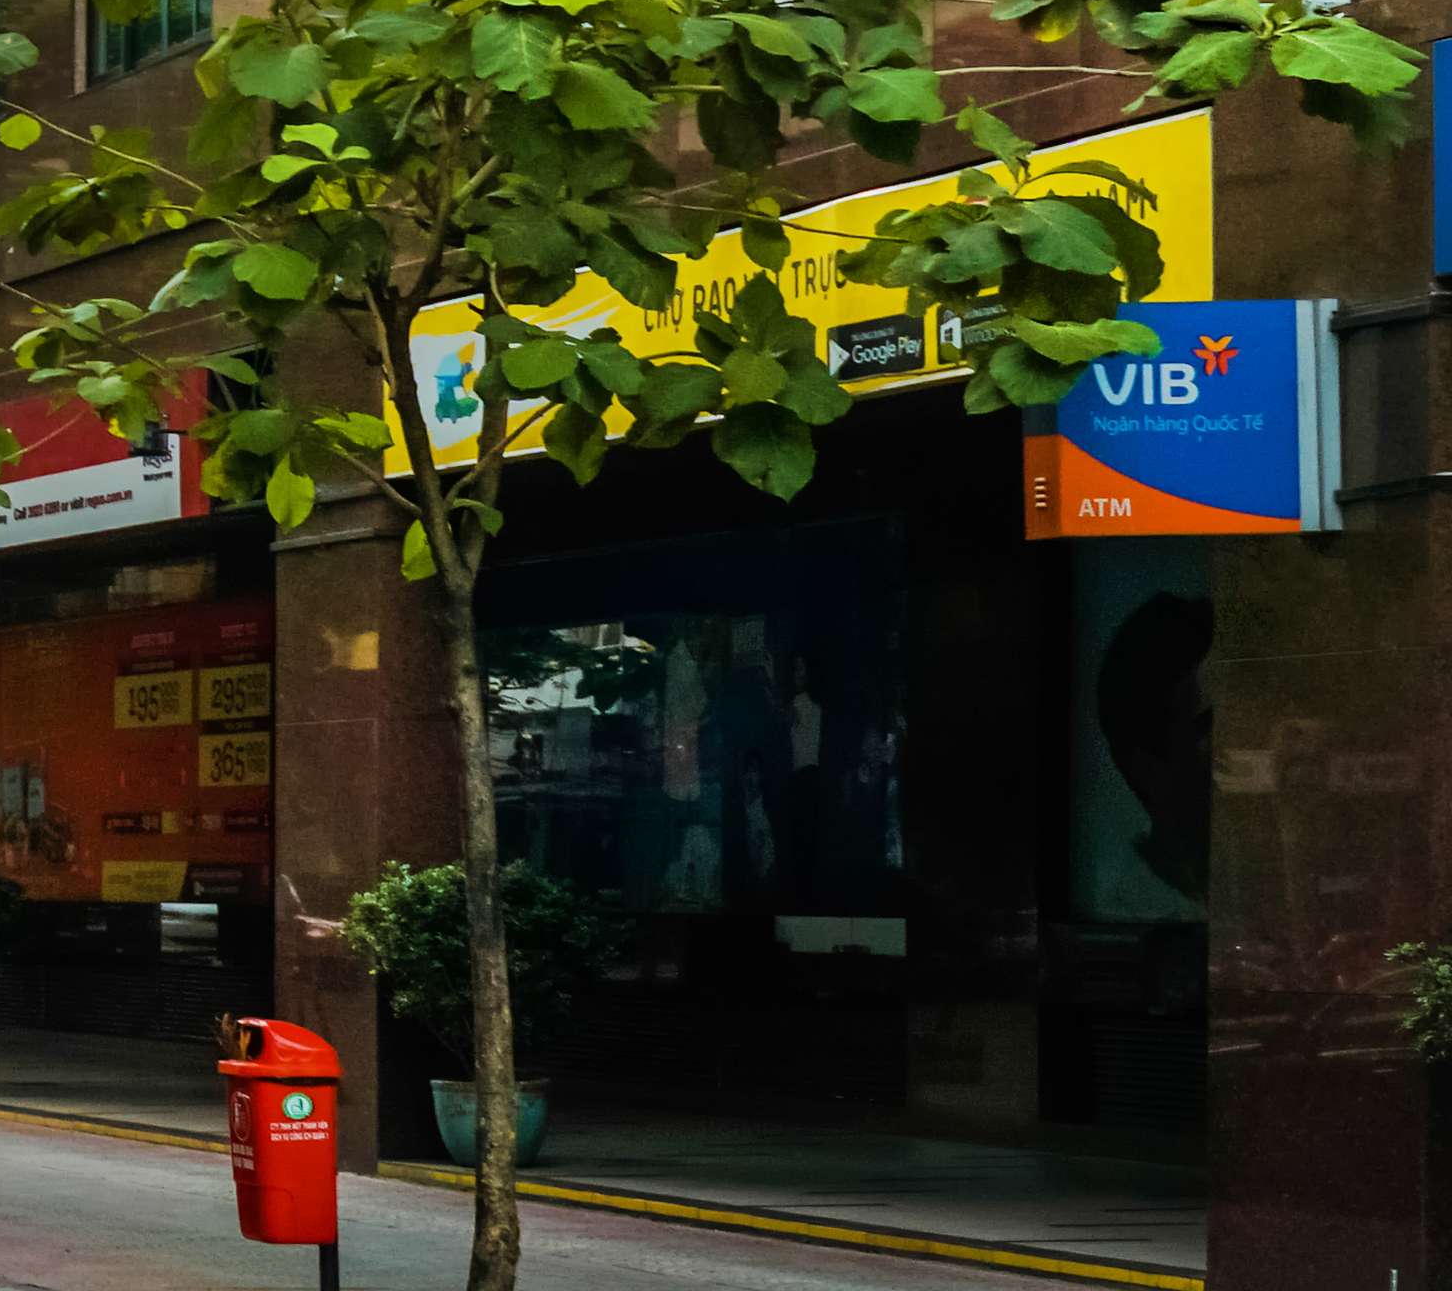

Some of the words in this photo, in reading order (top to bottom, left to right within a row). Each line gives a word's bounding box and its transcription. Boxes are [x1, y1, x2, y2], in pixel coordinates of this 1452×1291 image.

[851, 339, 897, 365] Google
[897, 336, 923, 358] Play
[1093, 363, 1199, 406] VIB
[1093, 415, 1140, 436] Ngân
[1144, 415, 1189, 435] hàng
[1194, 414, 1239, 441] Quốc
[1243, 413, 1264, 431] Tế
[1078, 498, 1132, 517] ATM
[211, 677, 246, 715] 295
[210, 740, 245, 782] 365
